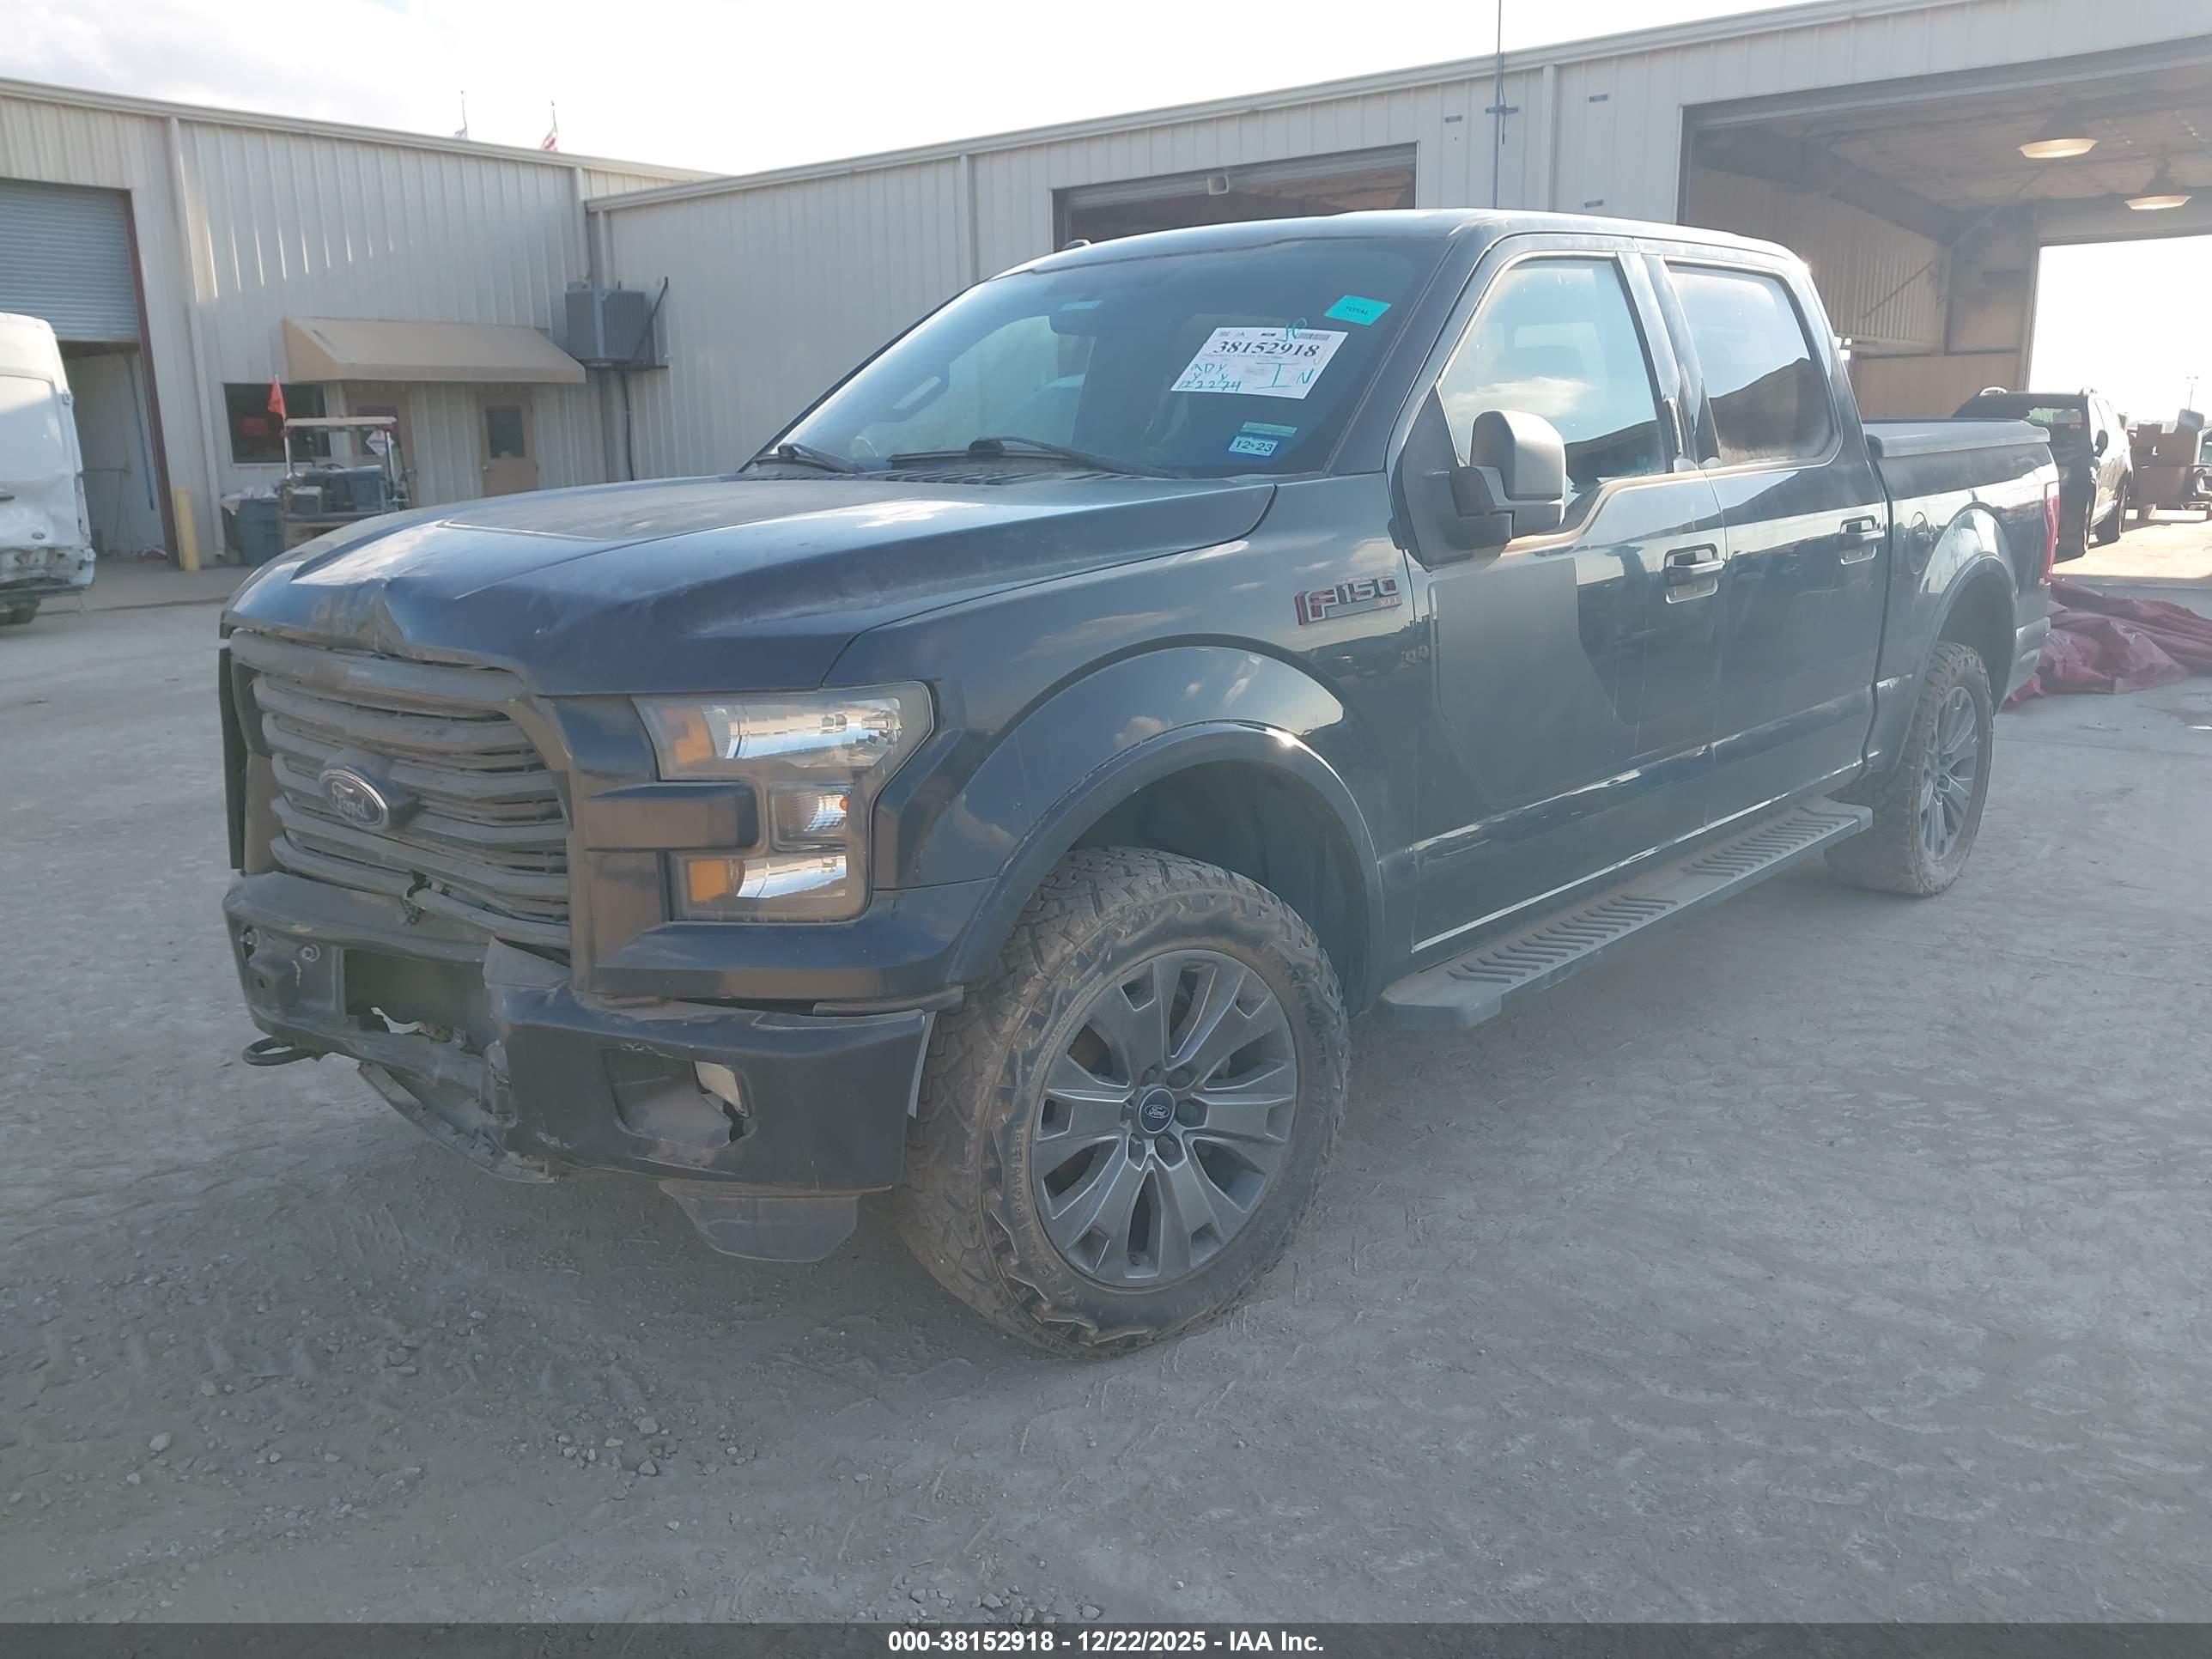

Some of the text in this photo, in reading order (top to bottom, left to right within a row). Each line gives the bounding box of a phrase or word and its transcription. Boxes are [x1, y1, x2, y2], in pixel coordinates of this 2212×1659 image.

[1213, 341, 1320, 357] 38152918
[330, 781, 370, 821] Ford
[1148, 1106, 1167, 1117] Ford
